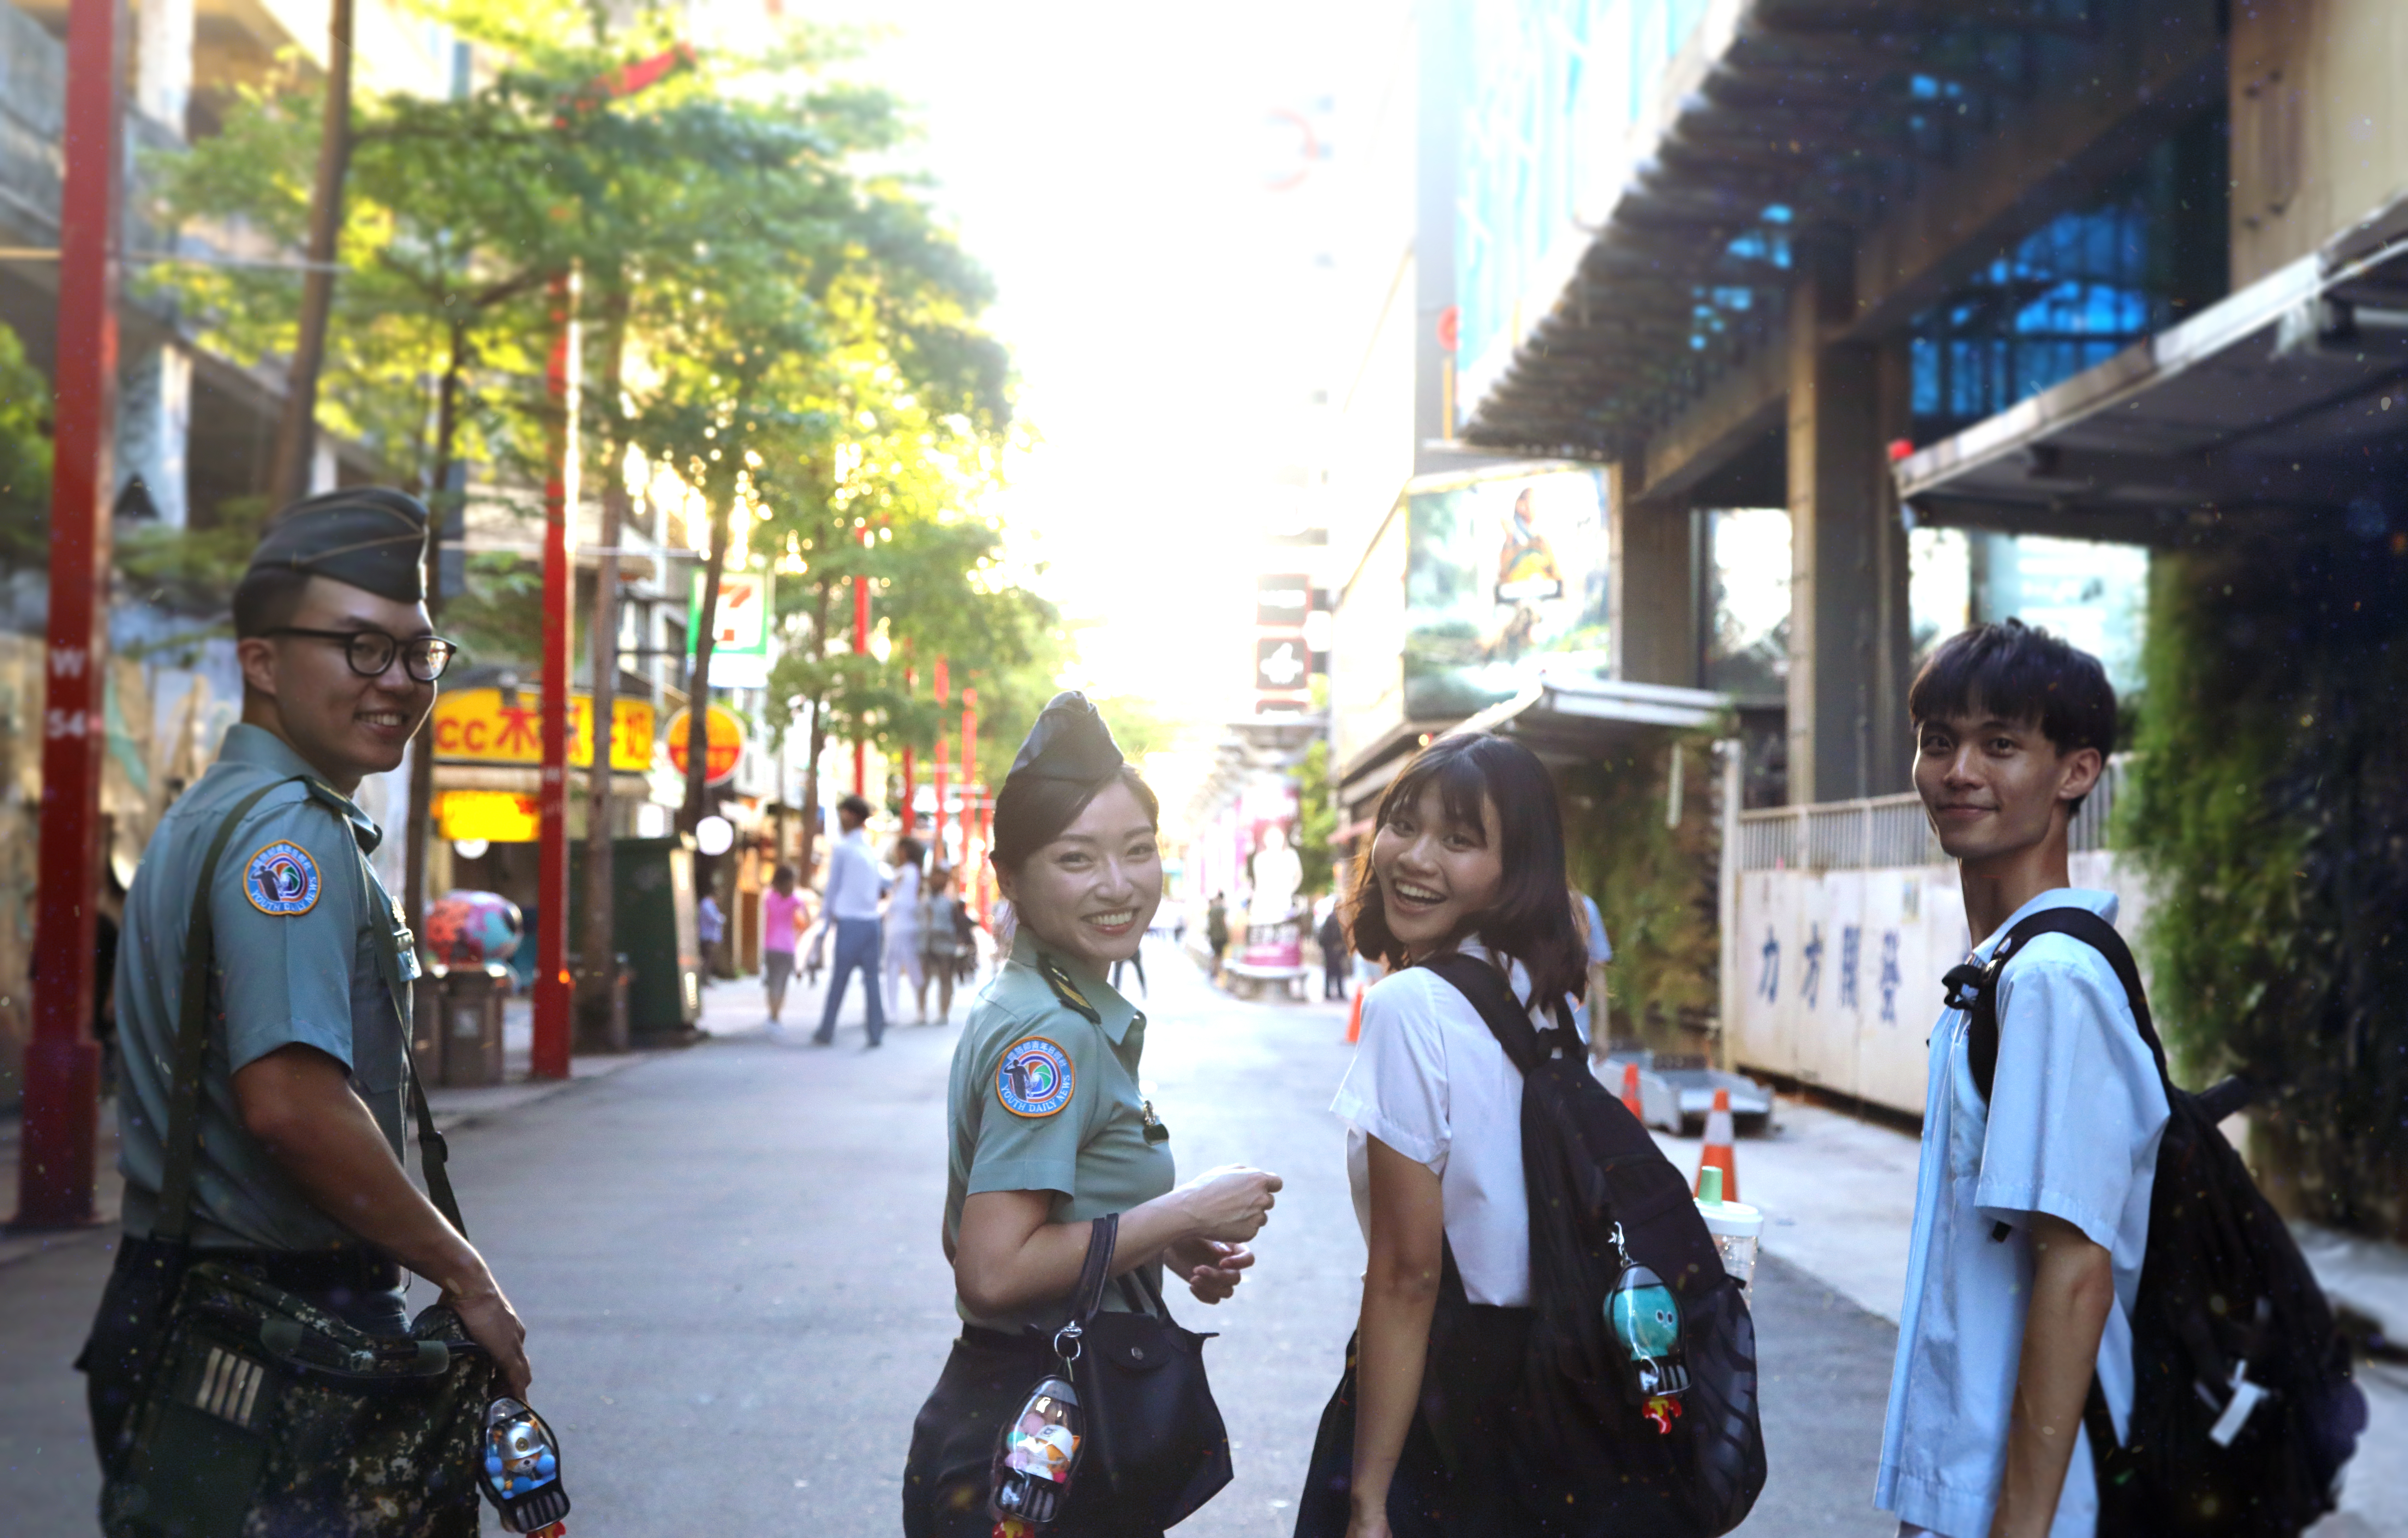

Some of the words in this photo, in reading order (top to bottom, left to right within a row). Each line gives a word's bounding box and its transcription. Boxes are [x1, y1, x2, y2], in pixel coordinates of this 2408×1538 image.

[50, 649, 85, 677] W
[251, 890, 281, 911] YOUTH
[1000, 1084, 1026, 1111] YOUTH
[1029, 1098, 1057, 1113] DAILY
[1056, 1074, 1071, 1102] NEWS
